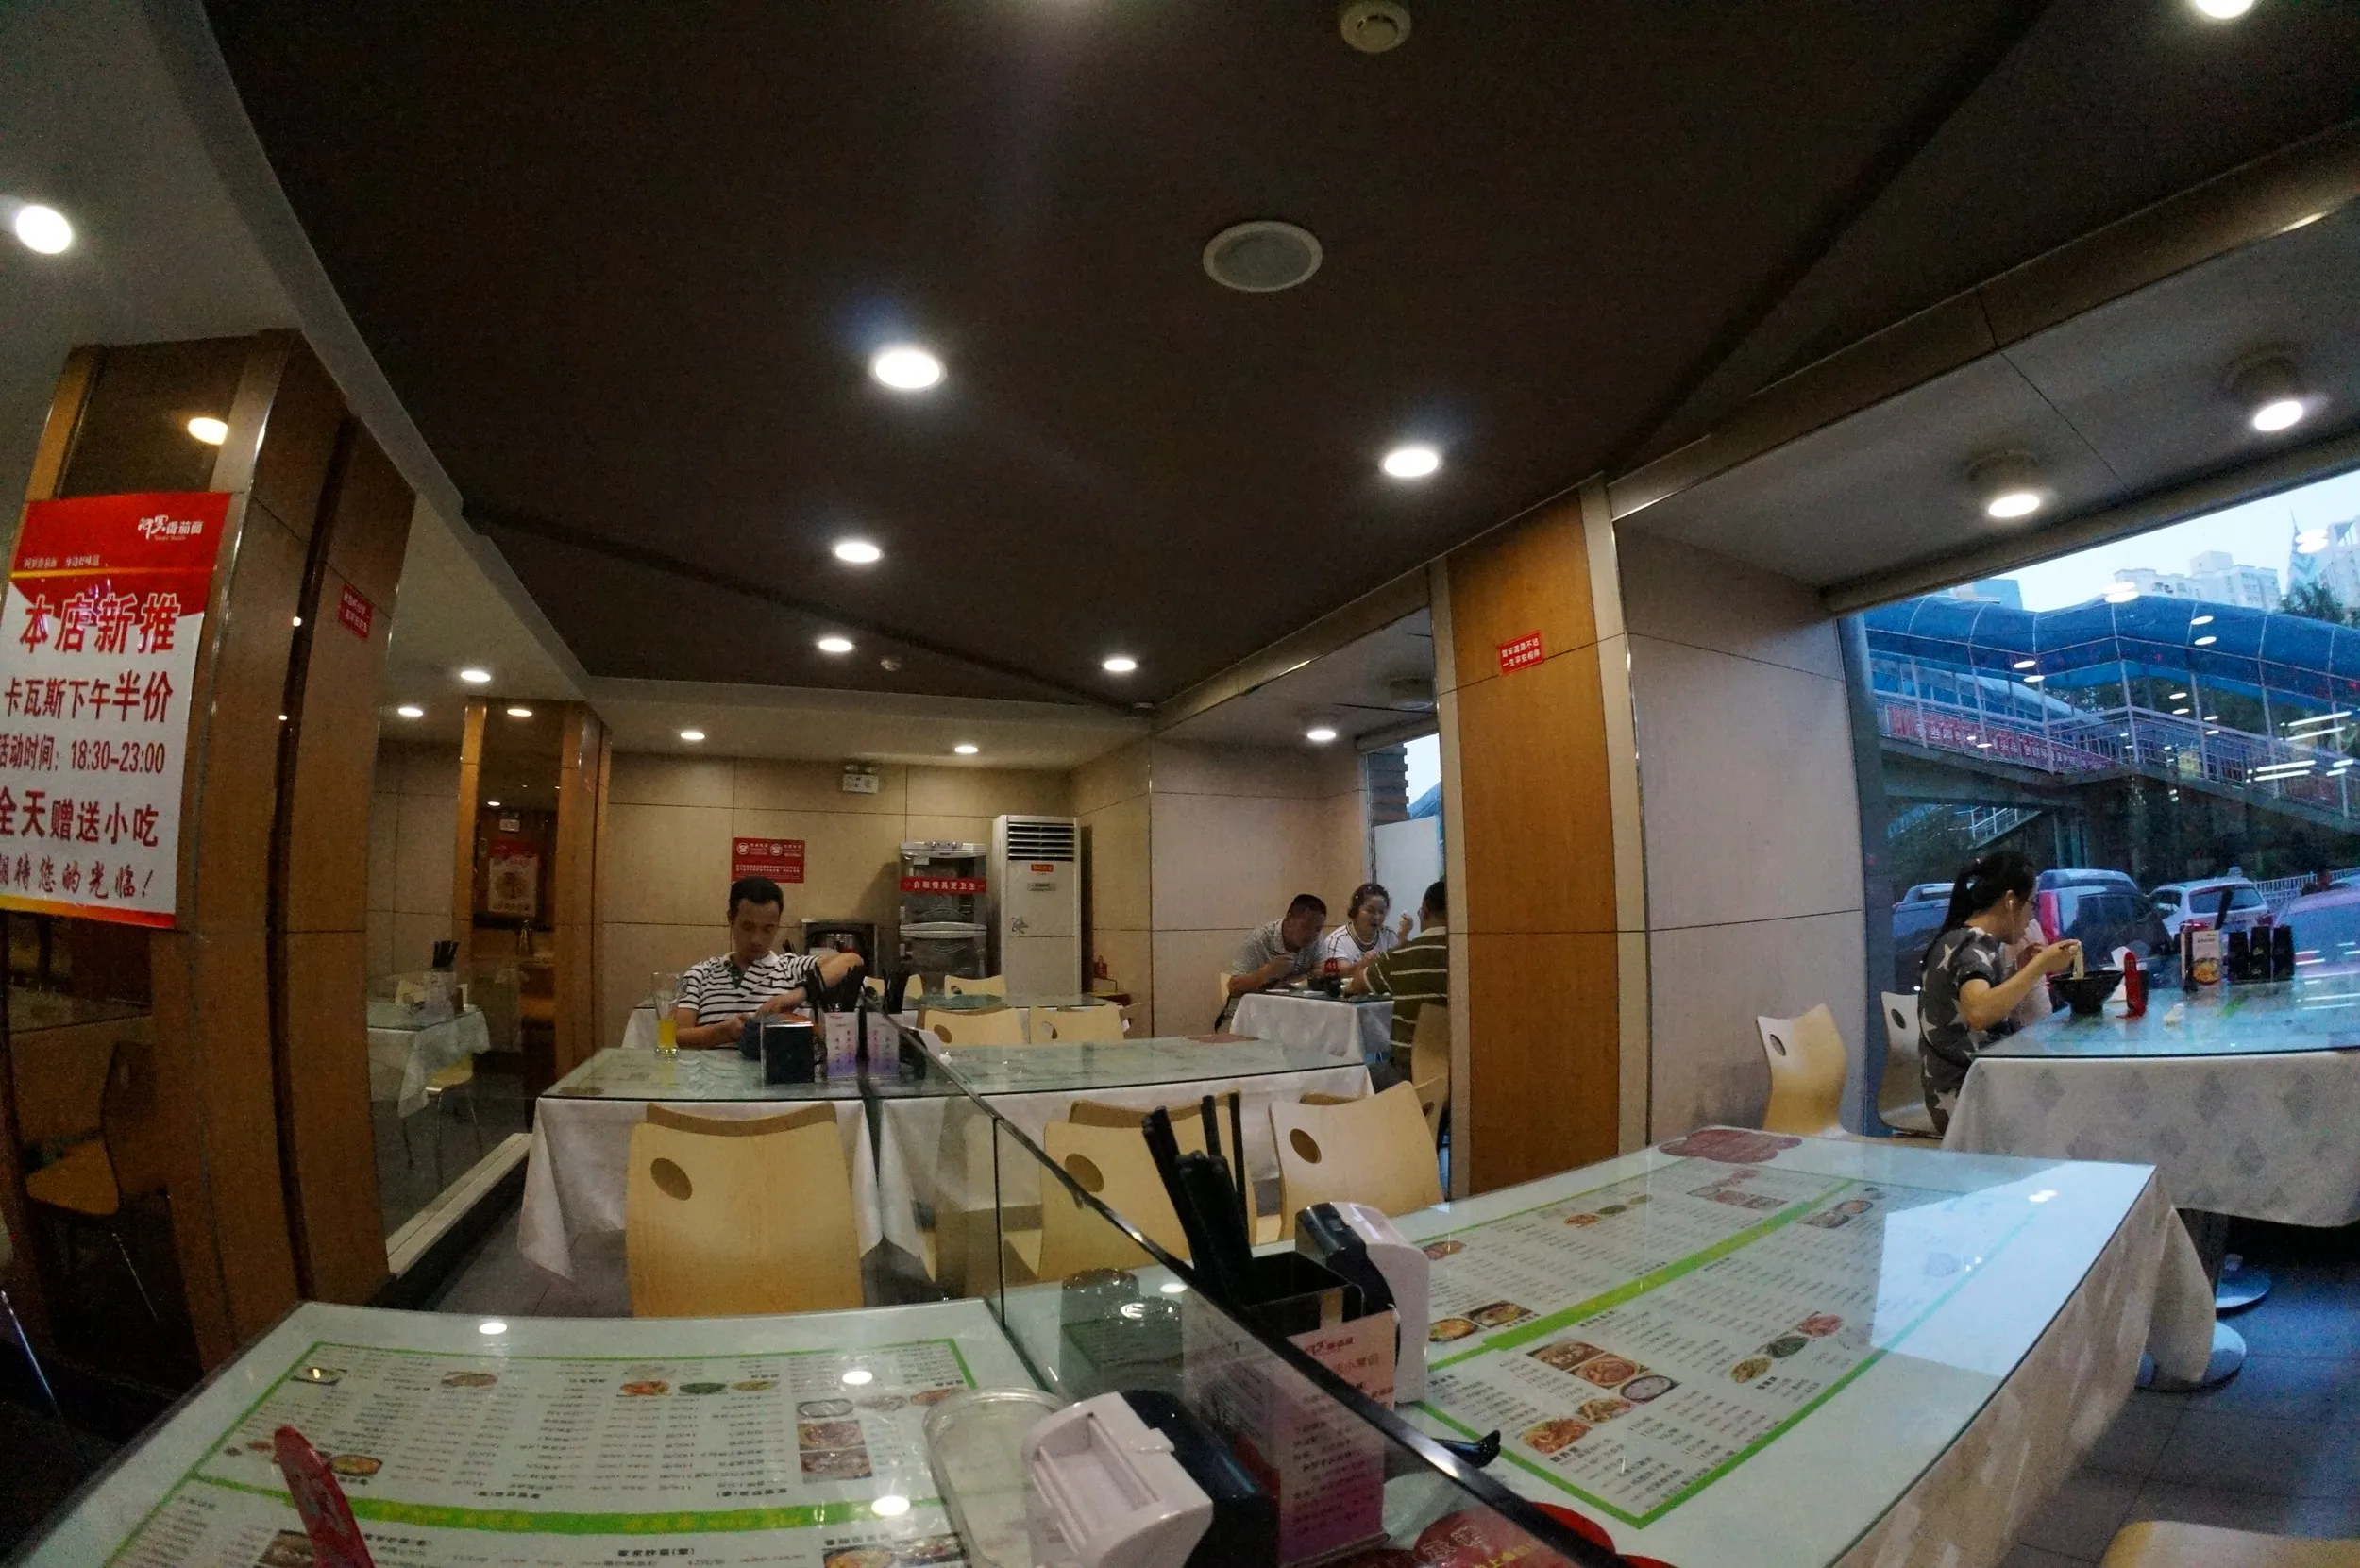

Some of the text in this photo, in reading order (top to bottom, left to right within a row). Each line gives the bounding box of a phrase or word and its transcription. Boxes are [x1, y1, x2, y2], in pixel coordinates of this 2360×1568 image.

[19, 593, 181, 654] 本店新推
[4, 669, 174, 722] 卡瓦斯下午半价
[0, 786, 160, 847] 全天赠送小吃
